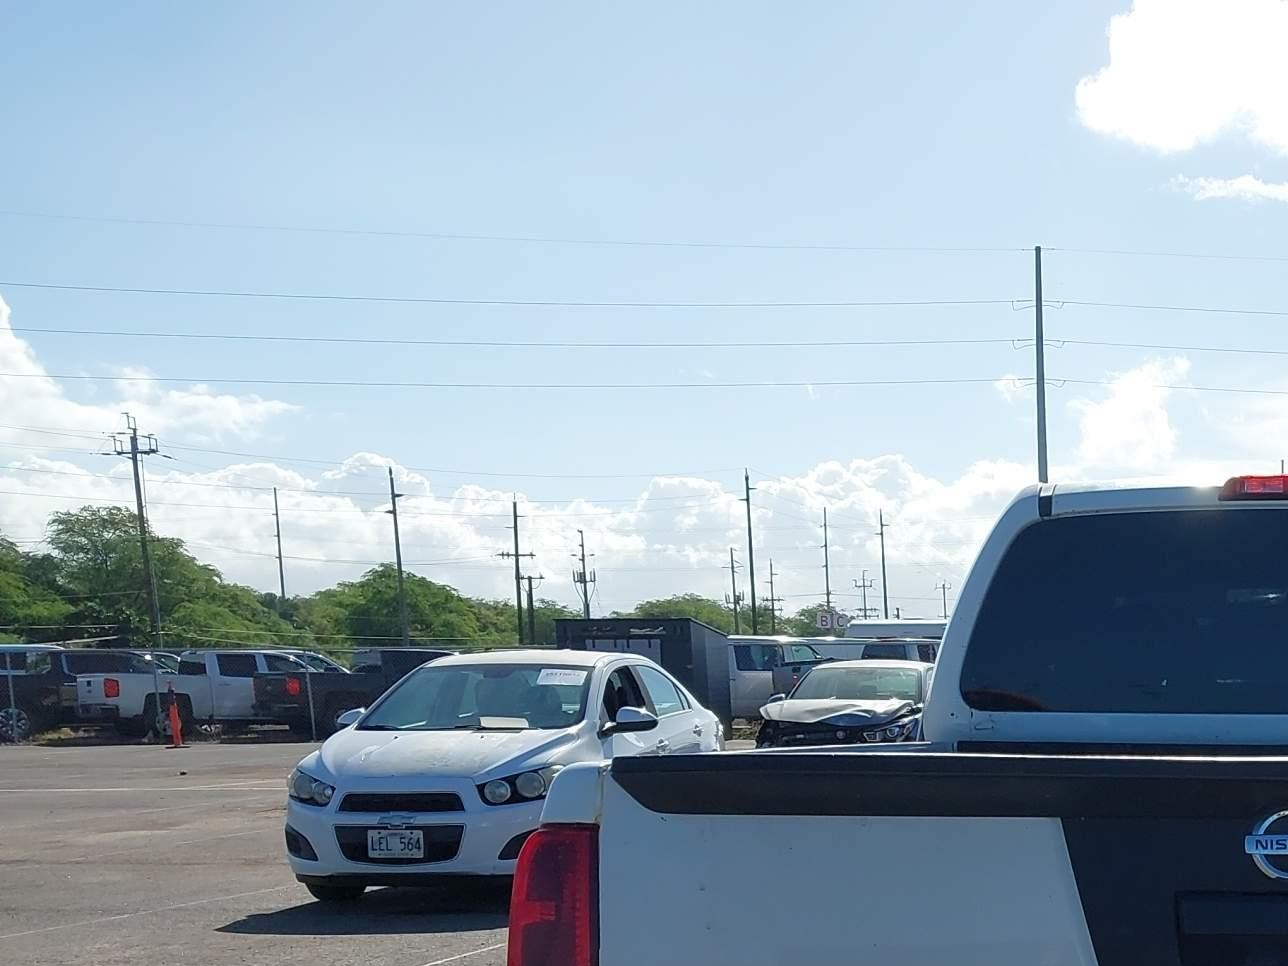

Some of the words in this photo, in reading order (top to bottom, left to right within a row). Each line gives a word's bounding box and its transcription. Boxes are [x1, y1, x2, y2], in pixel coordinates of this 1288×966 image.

[820, 615, 829, 627] B
[836, 614, 848, 627] C
[370, 835, 393, 851] LEL
[399, 836, 422, 851] 564
